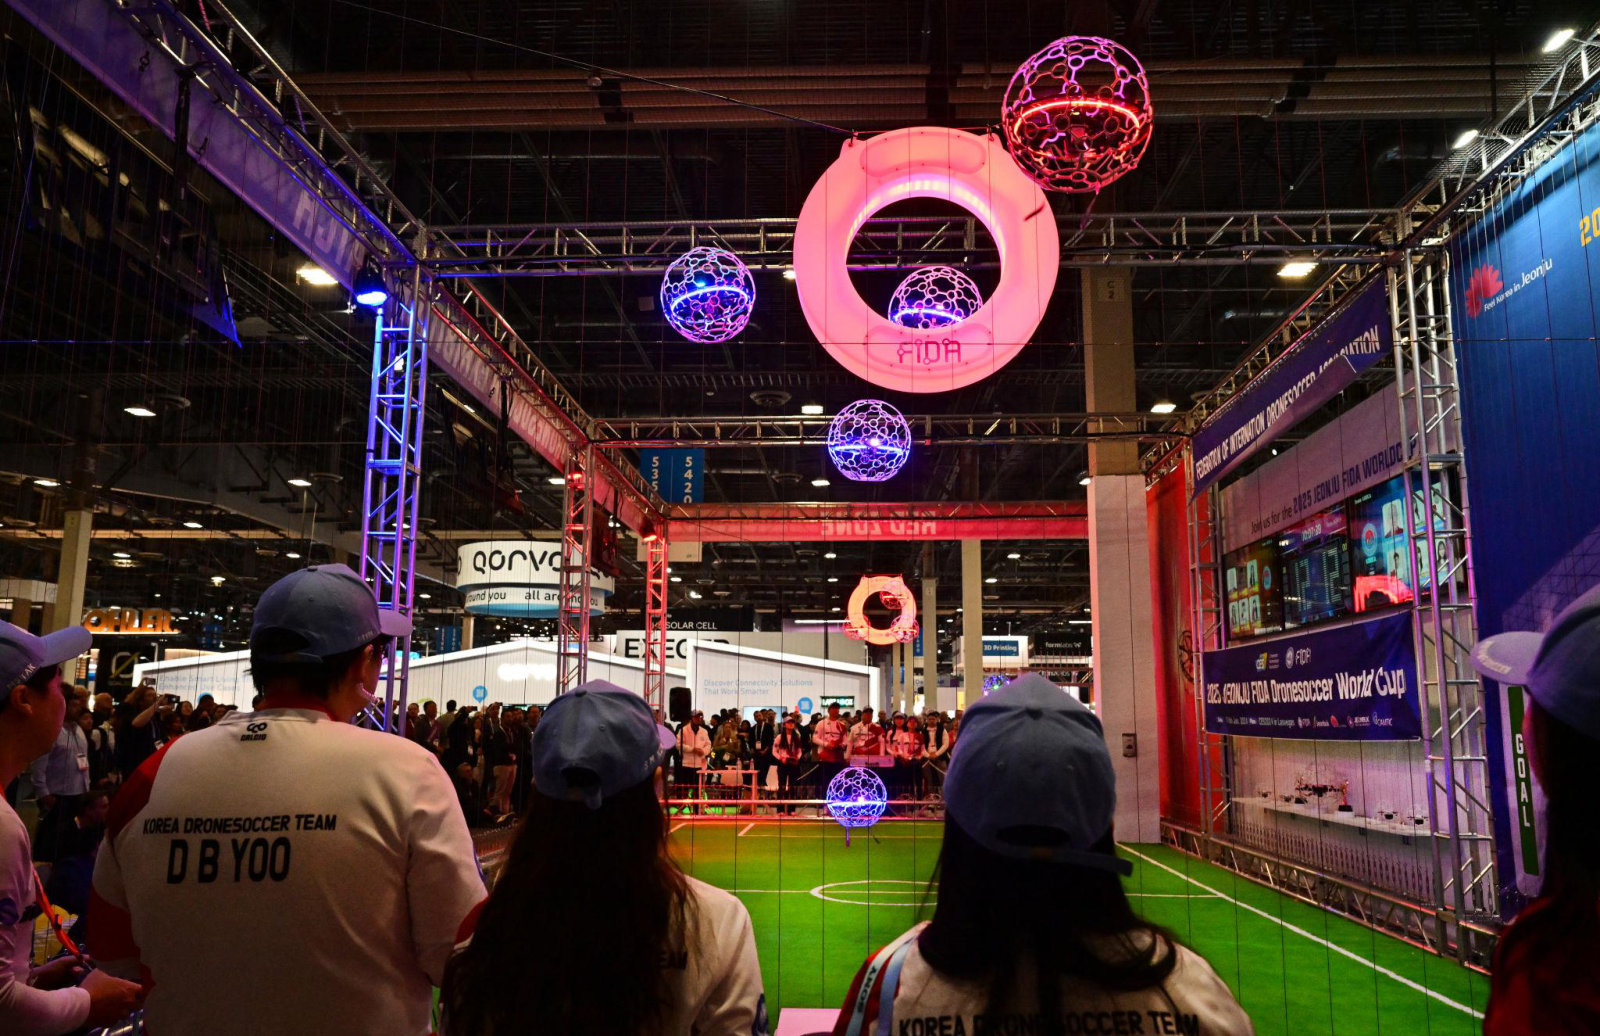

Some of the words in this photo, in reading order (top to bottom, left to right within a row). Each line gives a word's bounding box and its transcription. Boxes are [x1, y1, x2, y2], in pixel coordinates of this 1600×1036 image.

[1484, 301, 1496, 312] Feel
[1496, 287, 1513, 305] Korea
[1514, 282, 1521, 293] in
[1521, 258, 1553, 288] Jeonju
[897, 338, 961, 365] FIDA
[1196, 445, 1221, 480] FEDERATION
[1222, 438, 1229, 460] OF
[1229, 407, 1266, 456] INTERNATION
[1263, 516, 1271, 529] us
[1271, 511, 1281, 526] for
[1282, 505, 1293, 520] the
[1293, 490, 1312, 513] 2025
[1313, 474, 1340, 503] JEONJU
[1342, 466, 1361, 490] FIDA
[1362, 437, 1417, 478] WORLDCP
[488, 590, 507, 603] you
[525, 589, 541, 601] all
[666, 621, 694, 630] SOLAR
[695, 621, 718, 630] CELL
[983, 644, 992, 652] 3D
[993, 644, 1017, 653] Printing
[703, 678, 734, 687] Discover
[735, 678, 778, 688] Connectivity
[780, 679, 813, 687] Solutions
[740, 687, 769, 695] Smarter
[1251, 680, 1271, 704] FIDA
[1271, 678, 1334, 703] Dronesoccer
[1335, 668, 1374, 700] World
[1375, 666, 1407, 699] Cup
[1515, 733, 1531, 828] GOAL
[143, 817, 180, 835] KOREA
[184, 814, 291, 834] DRONESOCCER
[295, 813, 337, 831] TEAM
[167, 838, 189, 884] D
[198, 838, 220, 884] B
[231, 836, 291, 883] YOO
[857, 965, 878, 1014] SONY
[899, 1015, 966, 1036] KOREA
[1148, 1010, 1200, 1036] TEAM
